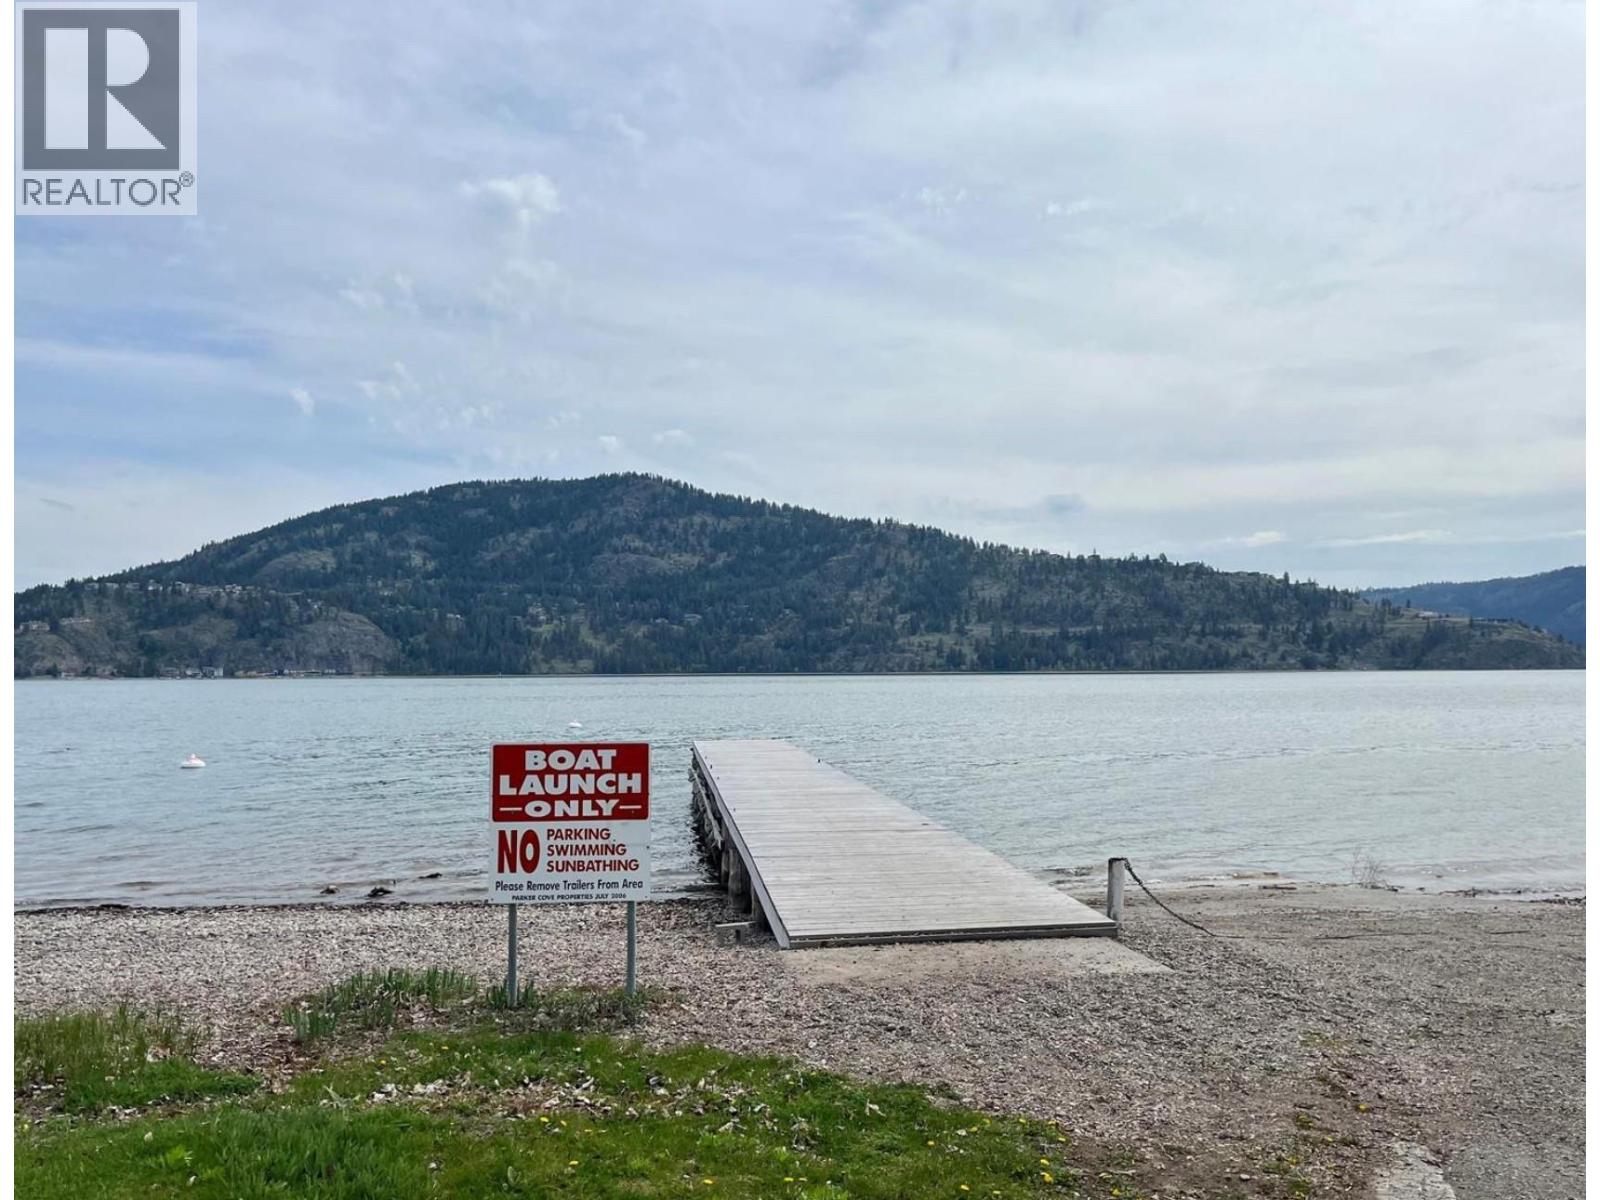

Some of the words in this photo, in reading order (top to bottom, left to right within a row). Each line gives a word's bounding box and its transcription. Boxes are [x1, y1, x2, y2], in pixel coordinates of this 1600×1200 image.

[525, 749, 617, 771] BOAT
[500, 773, 641, 795] LAUNCH
[524, 799, 620, 818] ONLY
[547, 828, 611, 841] PARKING
[497, 829, 540, 874] NO
[547, 843, 627, 856] SWIMMING
[546, 859, 639, 872] SUNBATHING
[495, 880, 524, 891] Please
[527, 880, 560, 891] Remove
[563, 879, 595, 890] Trailers
[597, 879, 619, 889] From
[622, 878, 643, 889] Area
